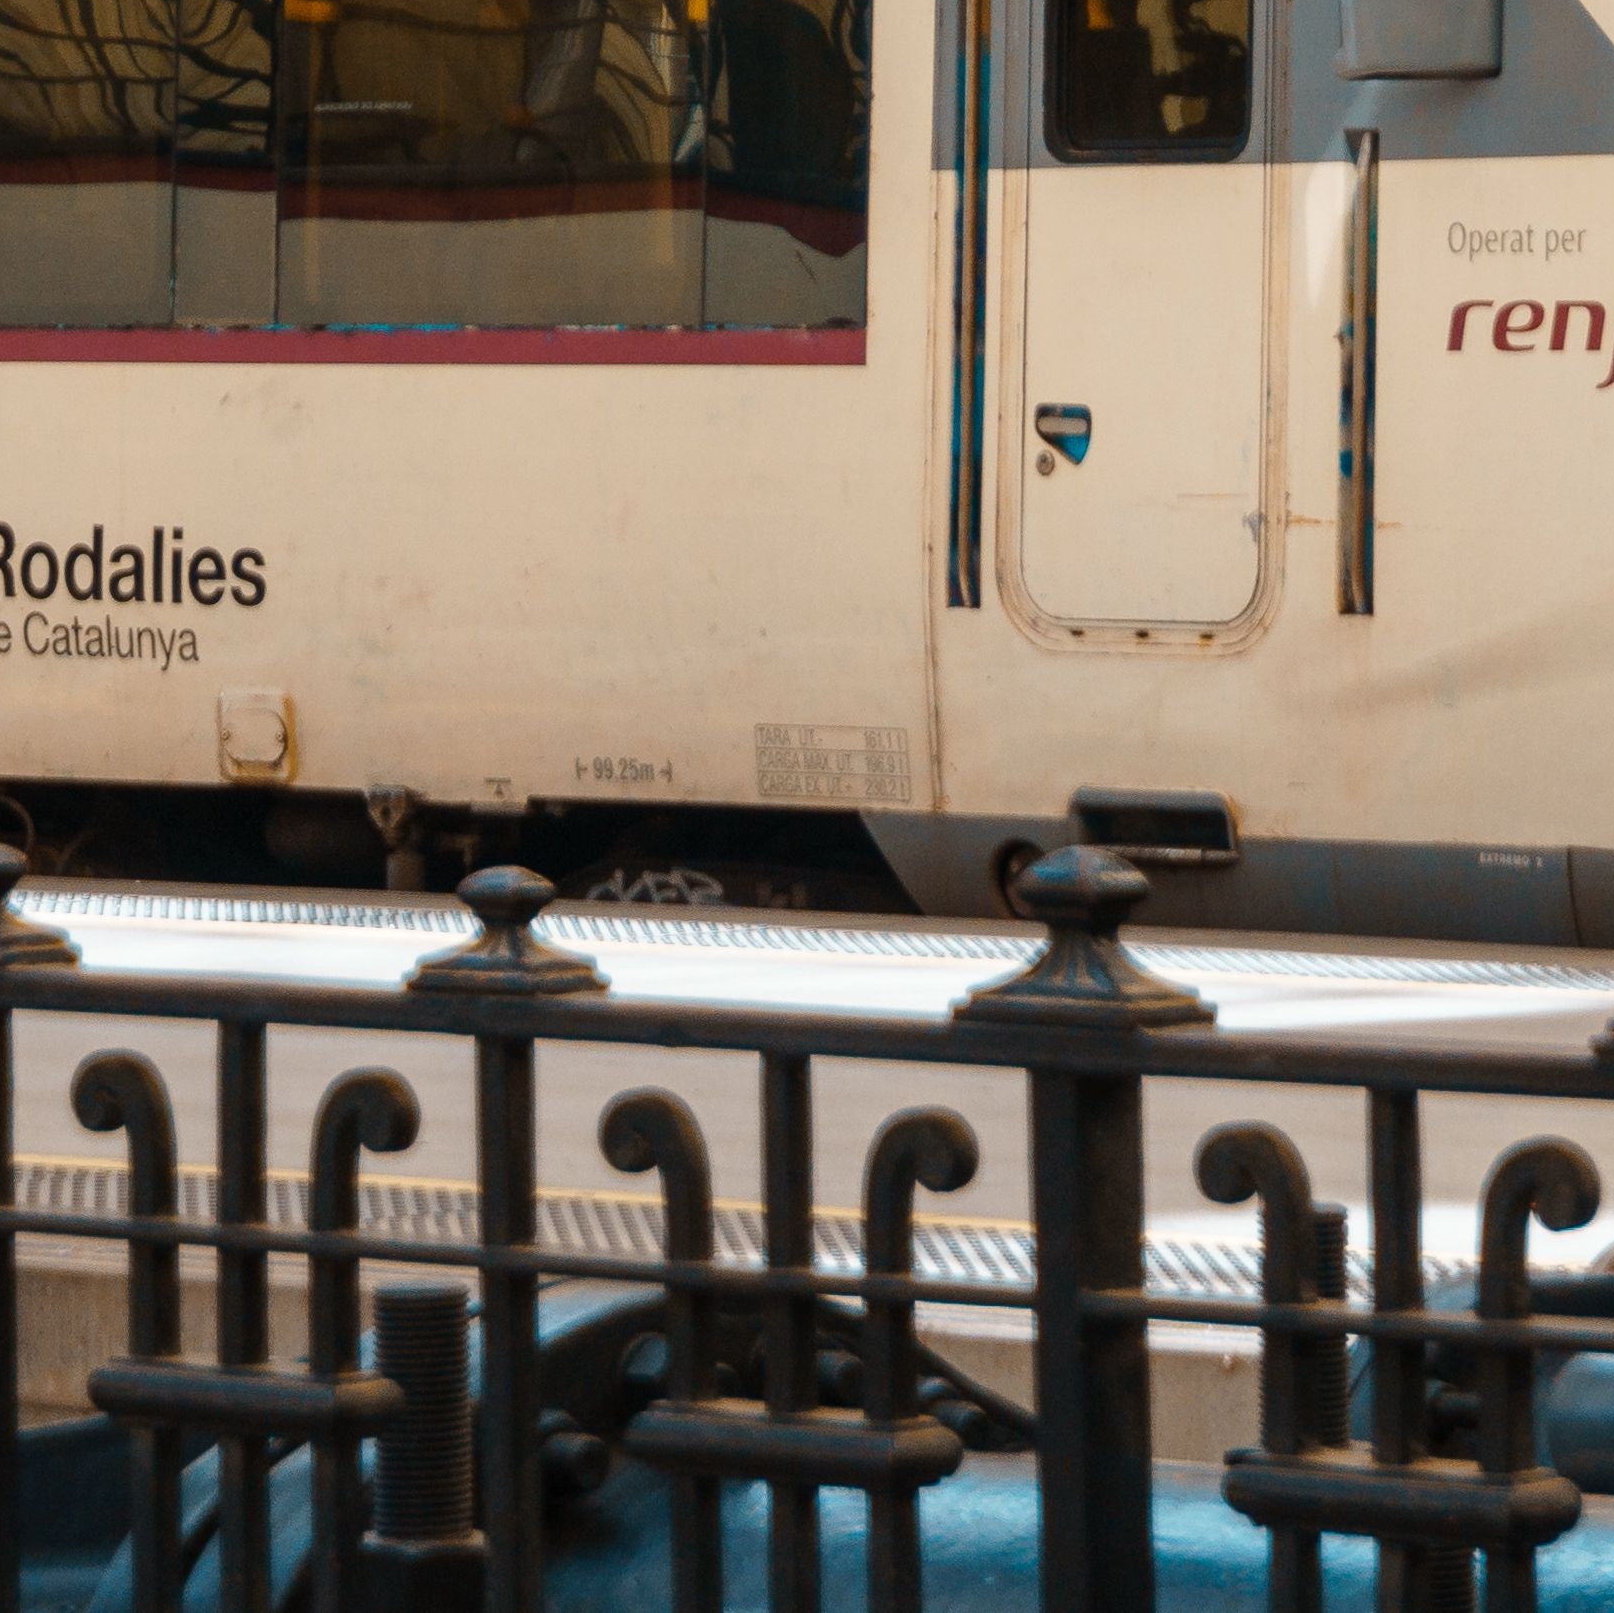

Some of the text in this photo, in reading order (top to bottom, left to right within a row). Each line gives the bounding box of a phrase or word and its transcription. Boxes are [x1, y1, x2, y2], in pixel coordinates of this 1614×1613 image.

[1447, 222, 1587, 261] Operat per
[23, 611, 201, 673] Catalunya
[592, 755, 656, 781] 99.25m
